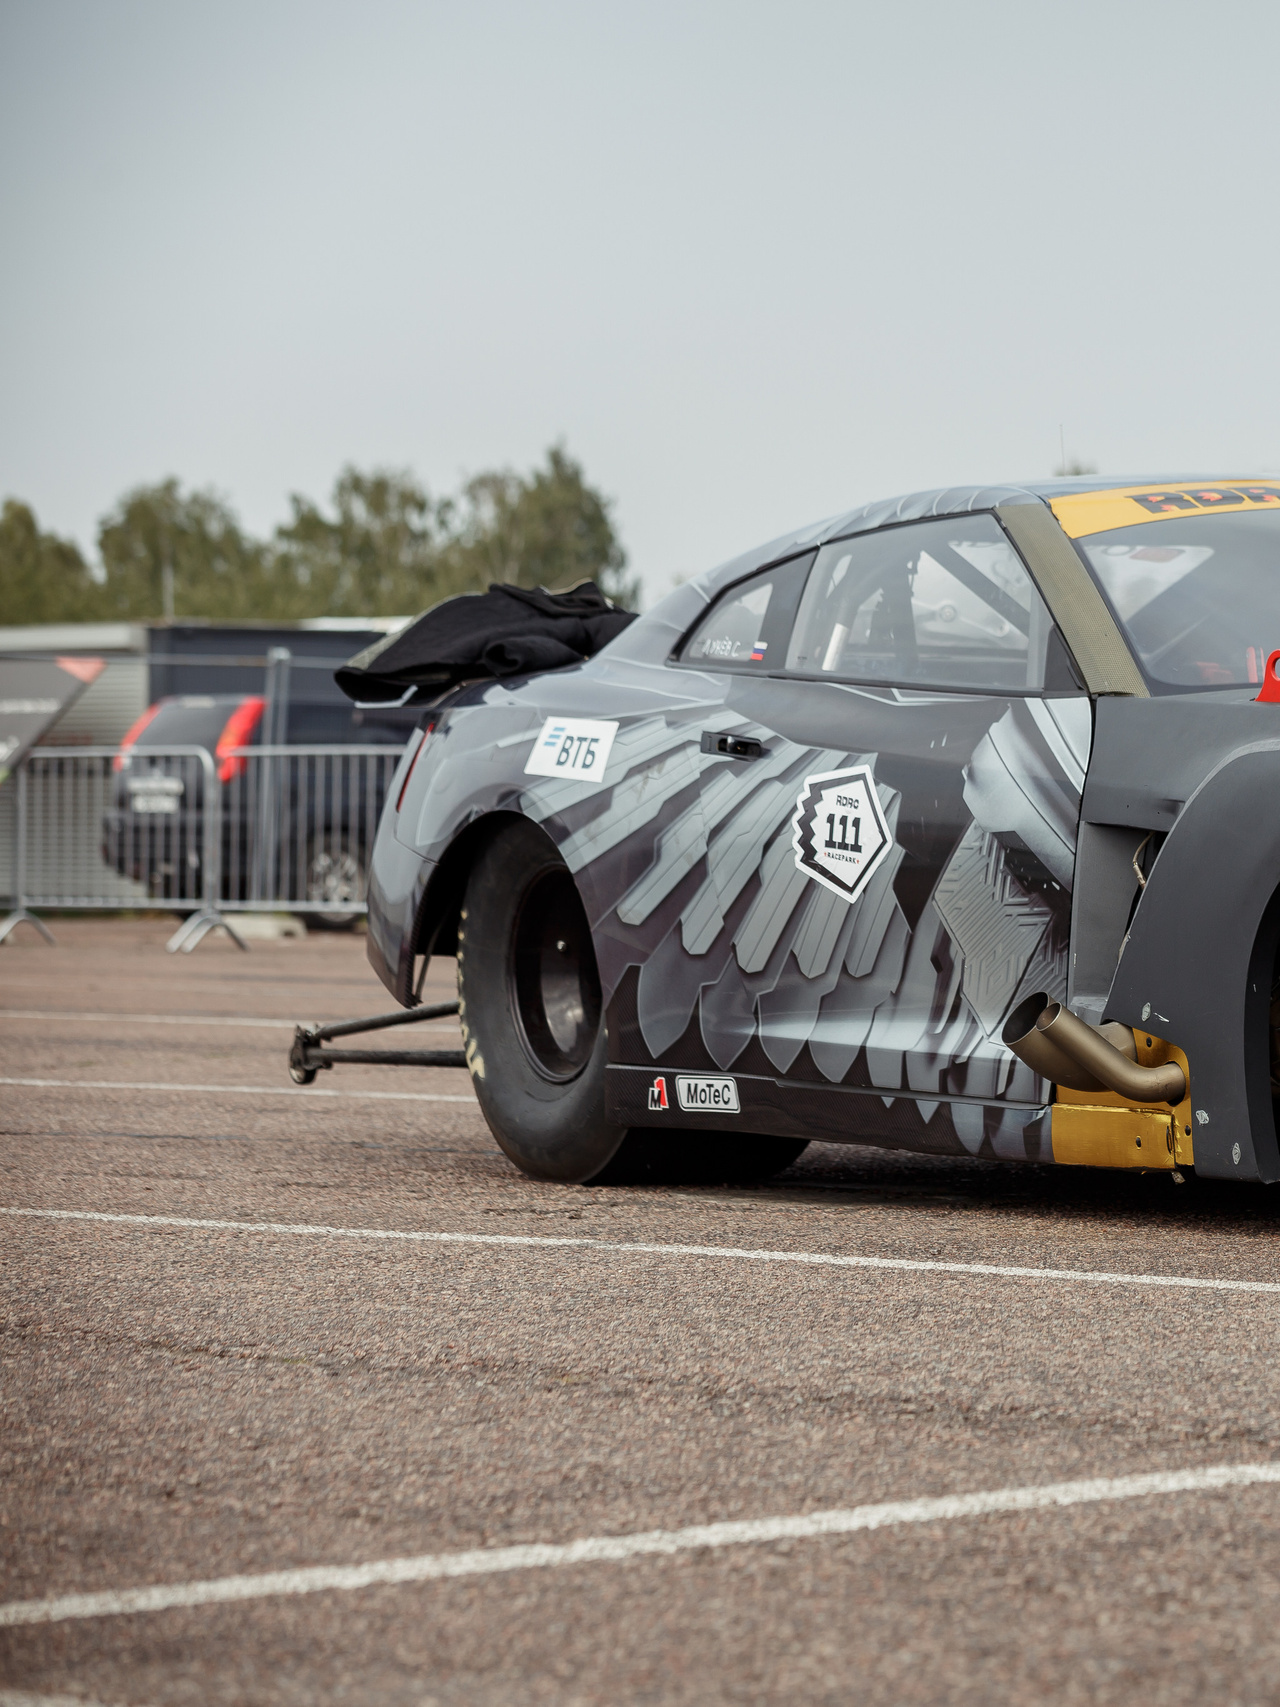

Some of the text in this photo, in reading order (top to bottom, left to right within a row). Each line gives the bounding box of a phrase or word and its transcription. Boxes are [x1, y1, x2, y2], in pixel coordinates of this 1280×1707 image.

[555, 735, 600, 769] ВТБ
[835, 794, 860, 810] RDRC
[824, 813, 863, 853] 111
[827, 851, 857, 865] RACEPARK
[686, 1082, 732, 1106] MoTeC
